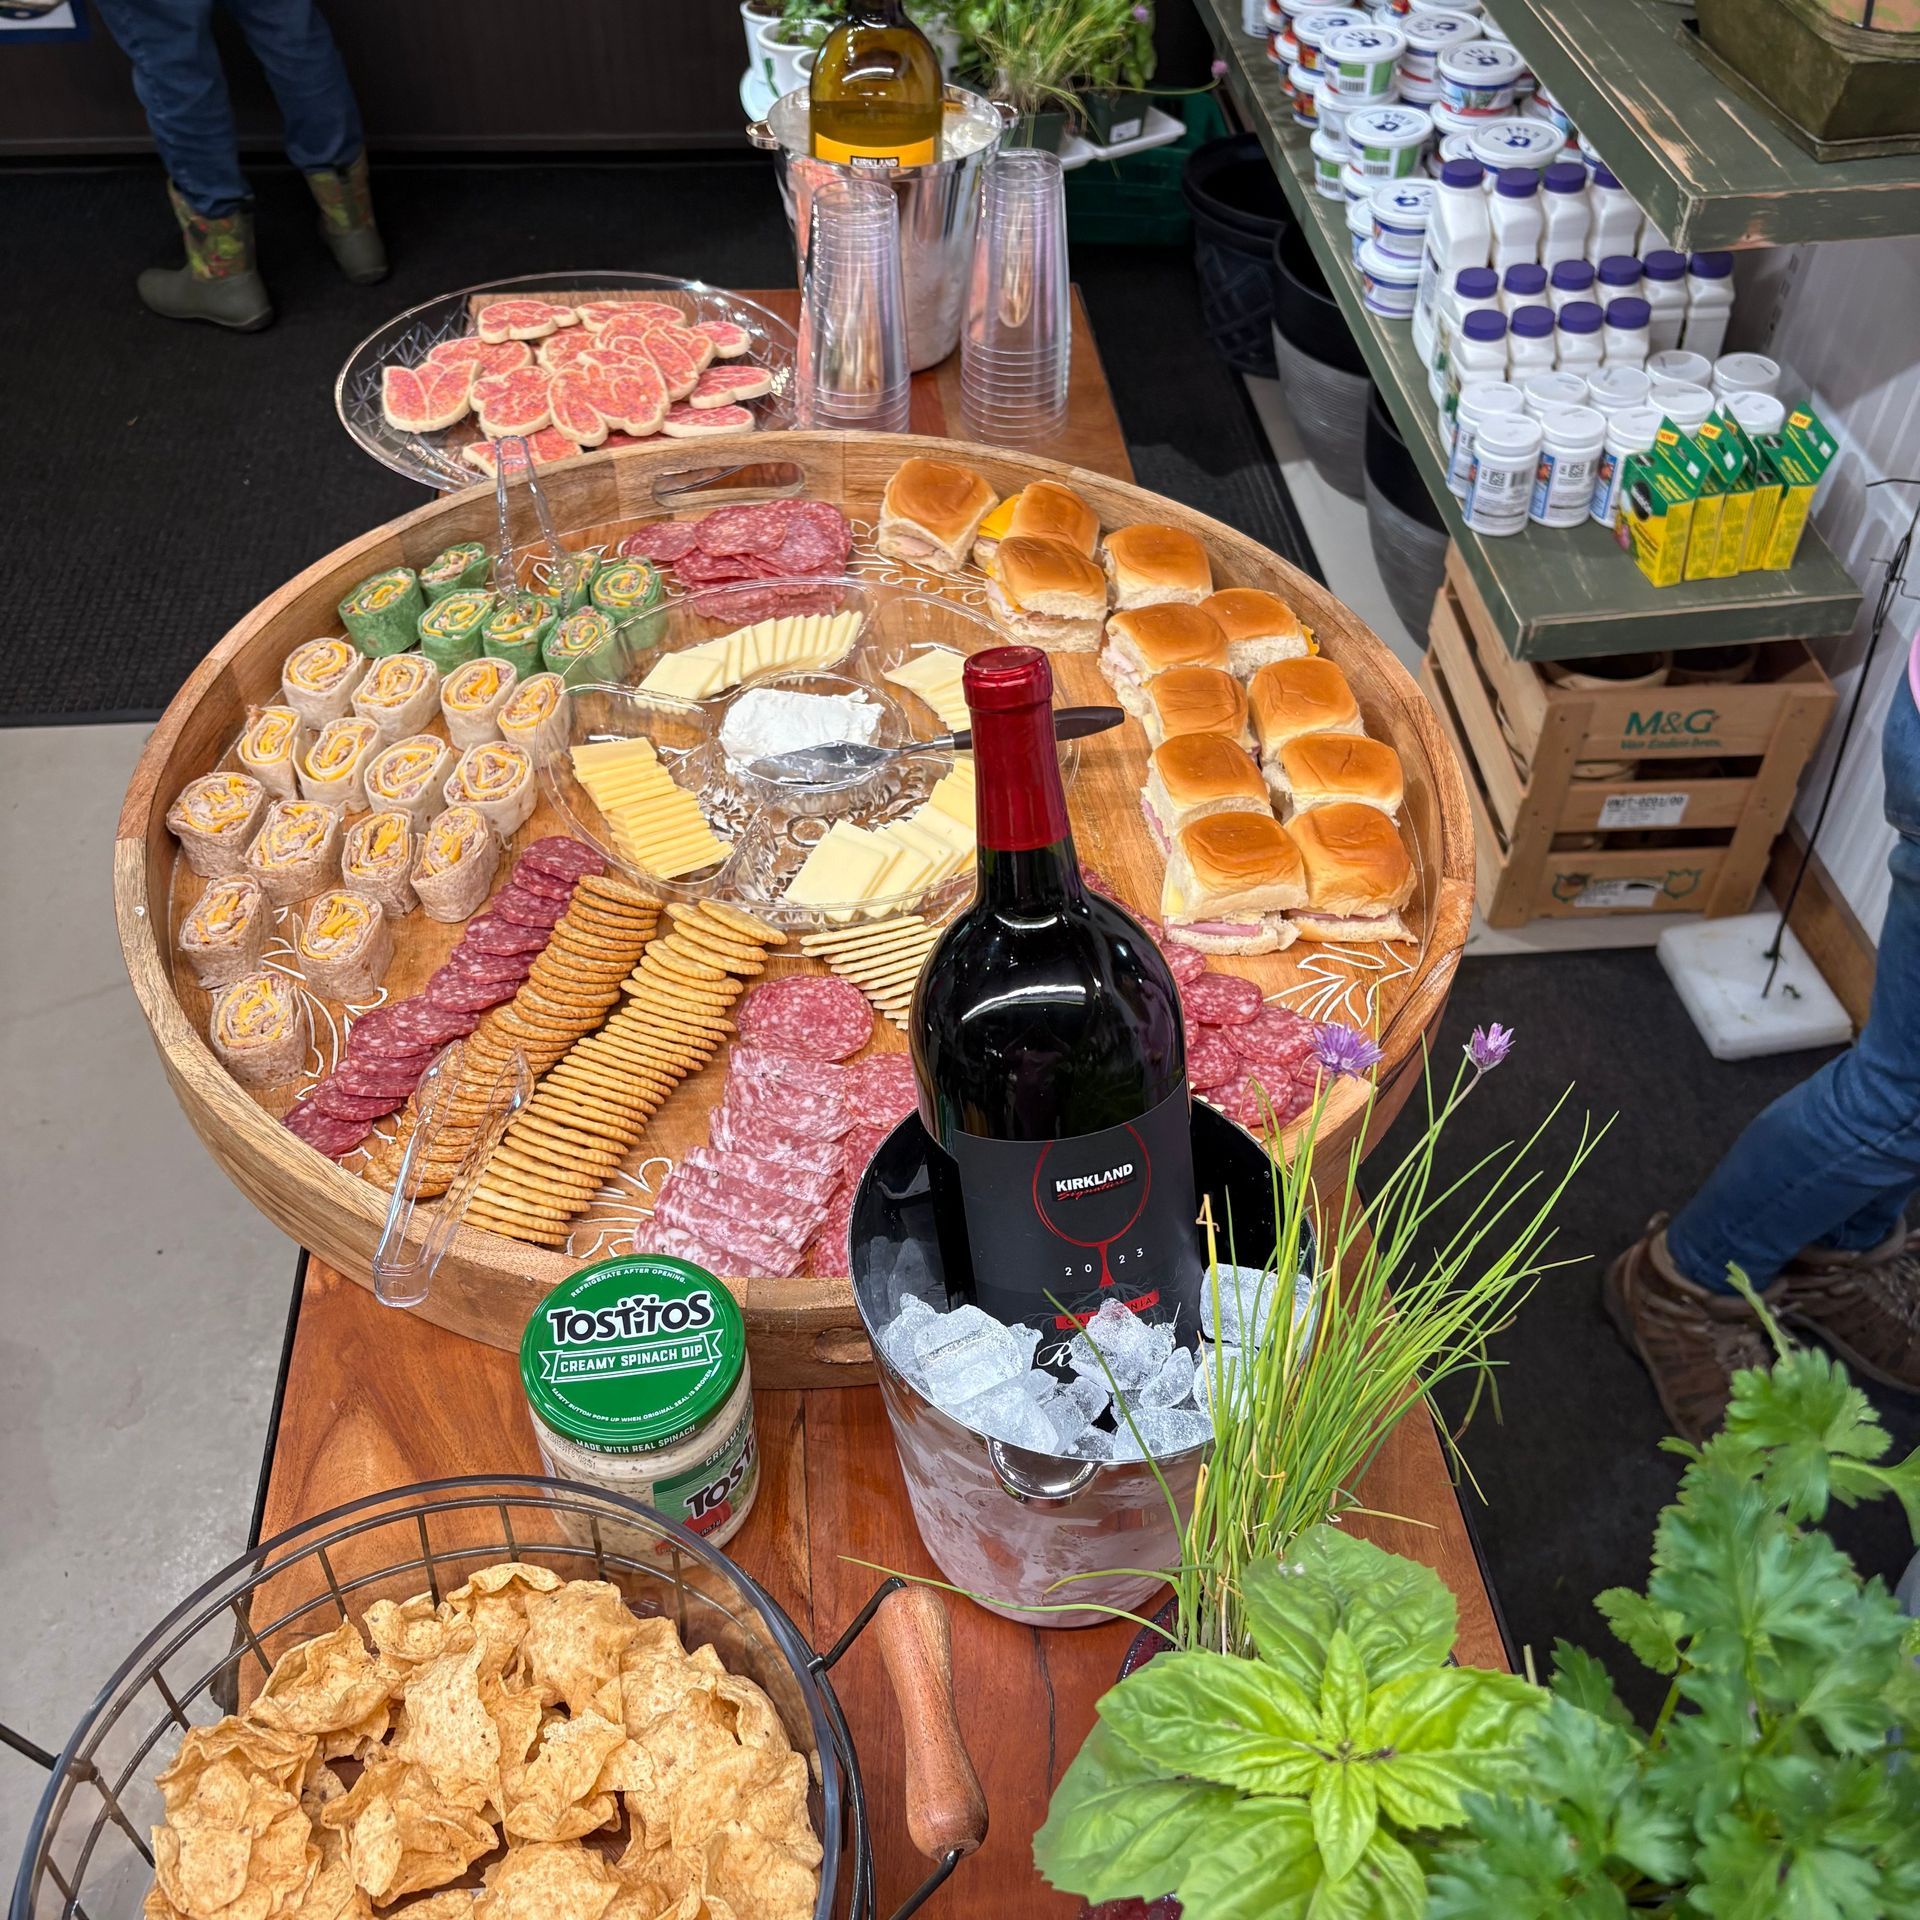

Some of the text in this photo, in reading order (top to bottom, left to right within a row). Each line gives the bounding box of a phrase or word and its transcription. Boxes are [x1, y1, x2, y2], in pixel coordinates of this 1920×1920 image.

[852, 157, 898, 168] KIRKLAND
[1623, 708, 1715, 736] M&G
[1055, 1163, 1134, 1192] KIRKLAND
[570, 1270, 621, 1298] REFRIGERATE
[560, 1344, 704, 1373] CREAMY SPINACH DIP
[551, 1387, 570, 1405] SAFETY
[568, 1403, 592, 1417] BUTTON
[643, 1405, 674, 1420] ORIGINAL
[674, 1395, 690, 1407] SEAL
[693, 1369, 713, 1392] BROKEN
[575, 1424, 696, 1453] MADE WITH REAL SPINACH
